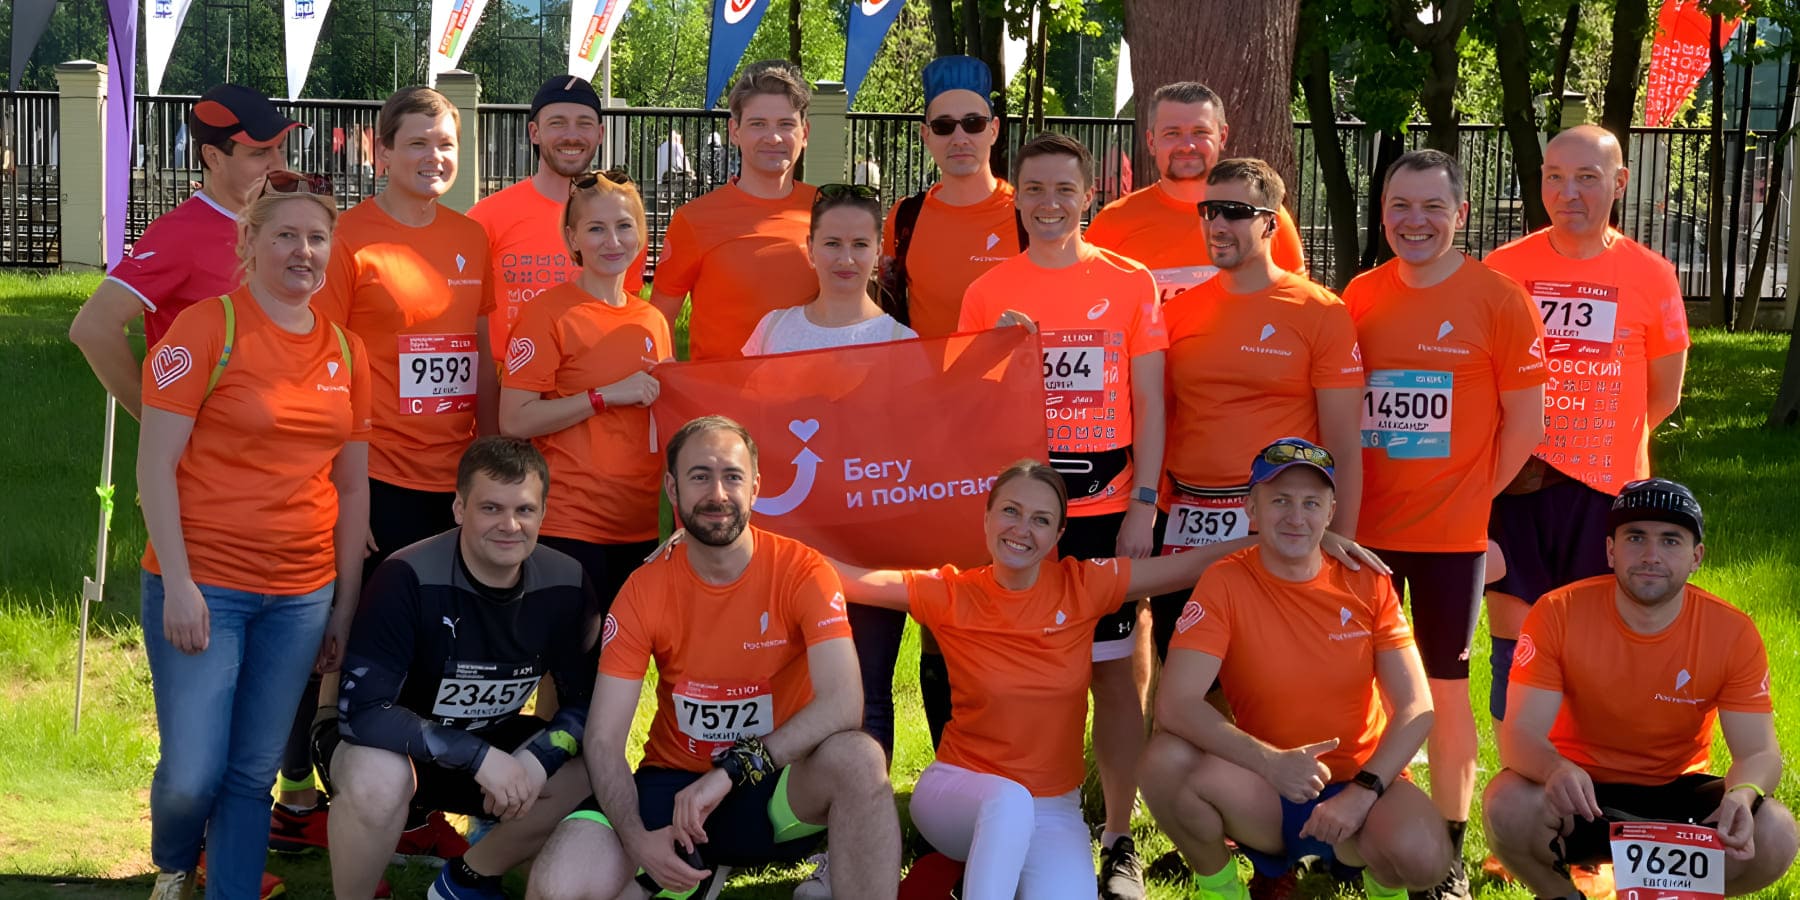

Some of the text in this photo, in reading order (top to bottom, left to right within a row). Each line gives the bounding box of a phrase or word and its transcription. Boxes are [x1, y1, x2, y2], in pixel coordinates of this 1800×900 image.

[1540, 300, 1593, 327] 713
[411, 356, 471, 384] 9593
[1364, 391, 1448, 420] 14500
[844, 457, 912, 483] Бегу
[846, 491, 863, 508] и
[1178, 508, 1237, 536] 7359
[439, 680, 537, 706] 23457
[683, 700, 759, 730] 7572
[1626, 844, 1709, 879] 9620
